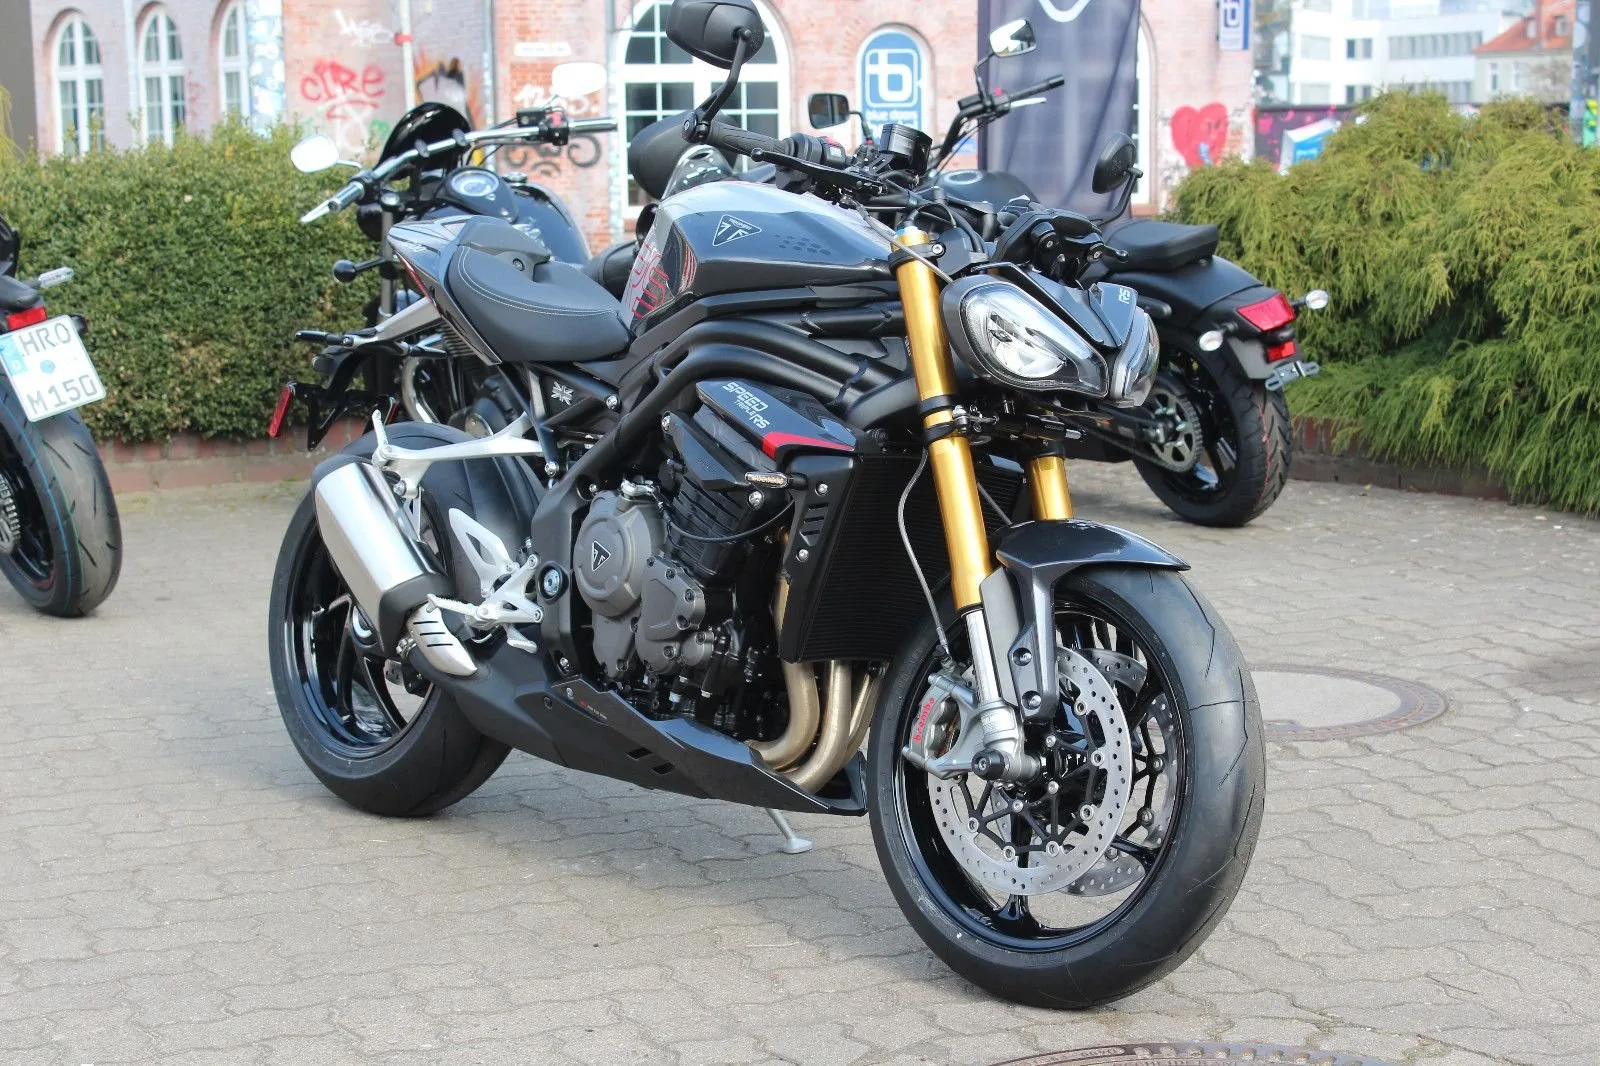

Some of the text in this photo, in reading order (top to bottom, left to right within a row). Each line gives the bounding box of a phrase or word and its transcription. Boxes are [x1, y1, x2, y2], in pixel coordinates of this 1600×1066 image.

[1119, 288, 1130, 304] RS
[19, 323, 71, 356] HRO
[27, 375, 97, 414] M 150
[722, 382, 769, 411] SPEED
[734, 400, 770, 429] TRIPLE RS
[913, 697, 935, 741] brembo
